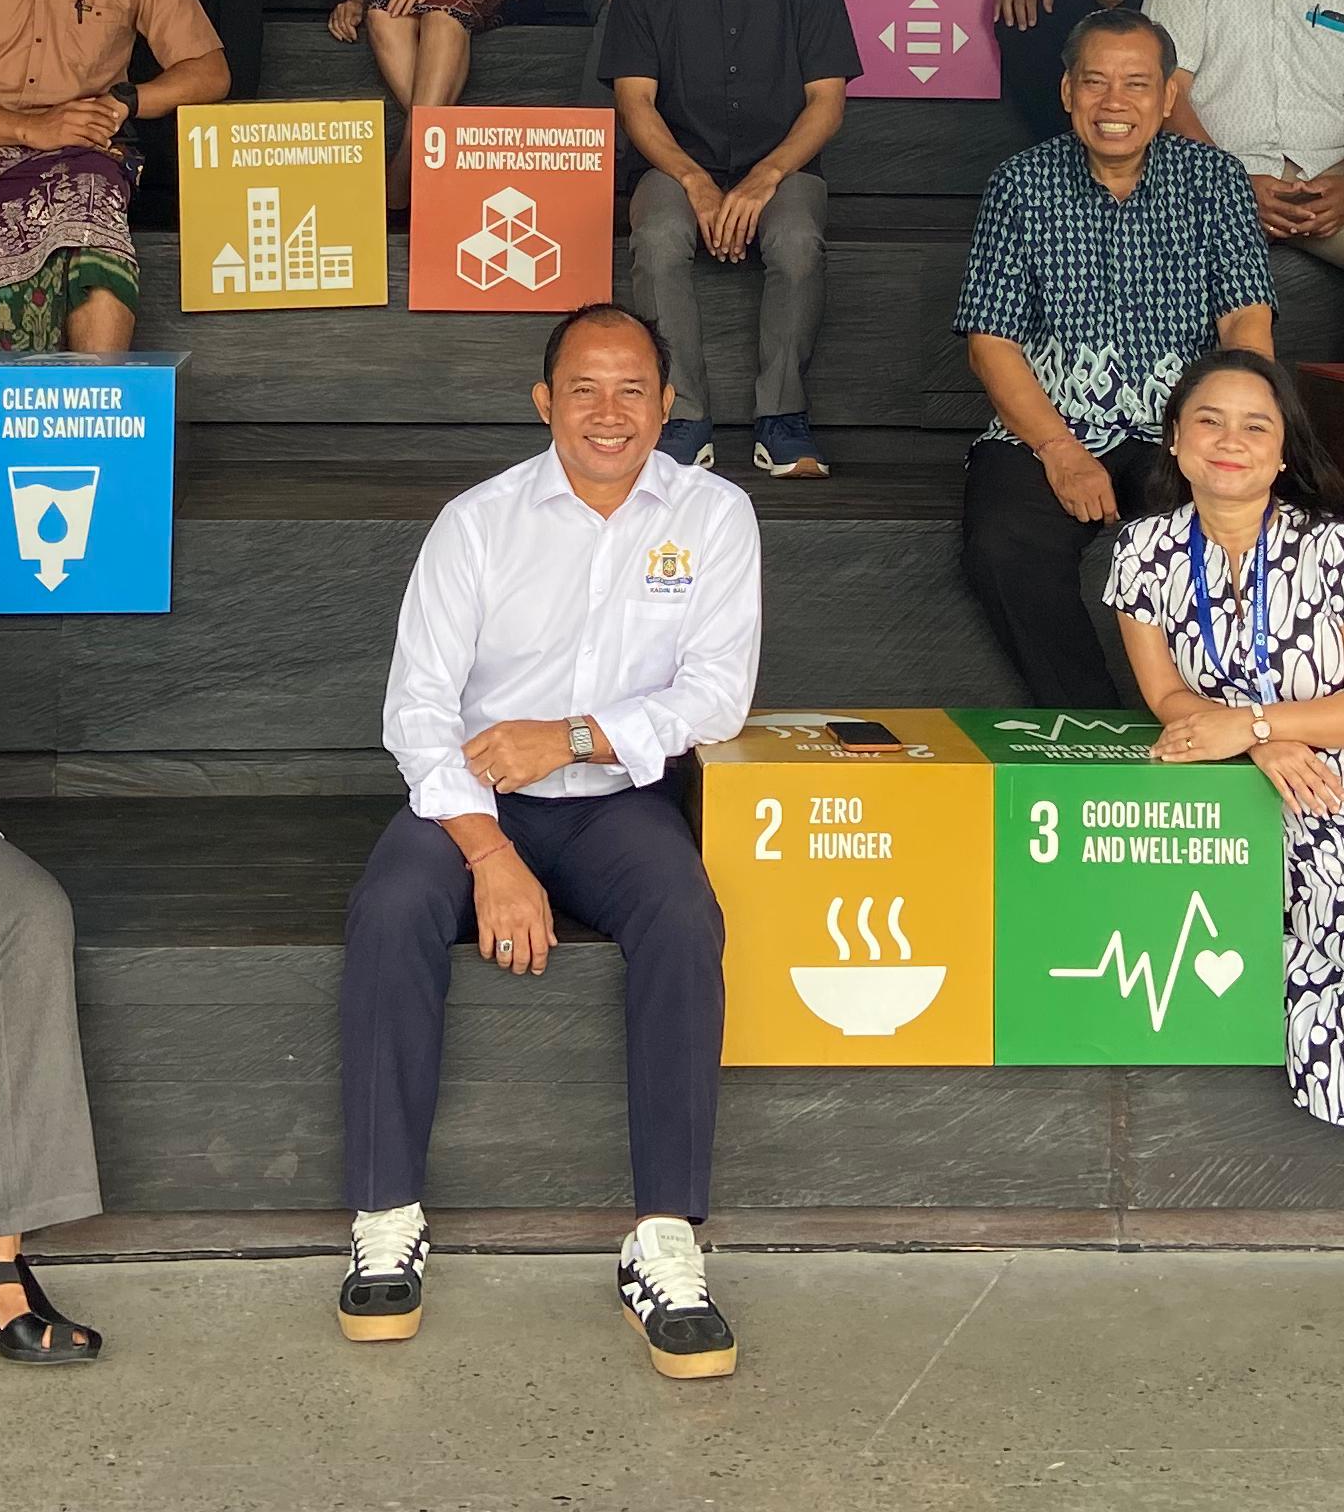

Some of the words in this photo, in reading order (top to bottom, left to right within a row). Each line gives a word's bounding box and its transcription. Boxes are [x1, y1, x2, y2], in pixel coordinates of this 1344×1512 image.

[188, 125, 219, 169] 11
[231, 123, 327, 144] SUSTAINABLE
[329, 120, 374, 141] CITIES
[231, 149, 262, 168] AND
[264, 145, 363, 167] COMMUNITIES
[424, 126, 446, 170] 9
[456, 127, 525, 149] INDUSTRY,
[526, 127, 605, 148] INNOVATION
[456, 151, 485, 170] AND
[485, 152, 603, 172] INFRASTRUCTURE
[2, 388, 59, 411] CLEAN
[62, 388, 123, 411] WATER
[1, 415, 40, 439] AND
[42, 415, 146, 439] SANITATION
[754, 798, 783, 861] 2
[808, 797, 863, 826] ZERO
[1029, 800, 1059, 864] 3
[1081, 801, 1140, 829] GOOD
[1143, 802, 1221, 830] HEALTH
[808, 832, 893, 860] HUNGER
[1081, 835, 1129, 864] AND
[1131, 836, 1249, 865] WELL-BEING
